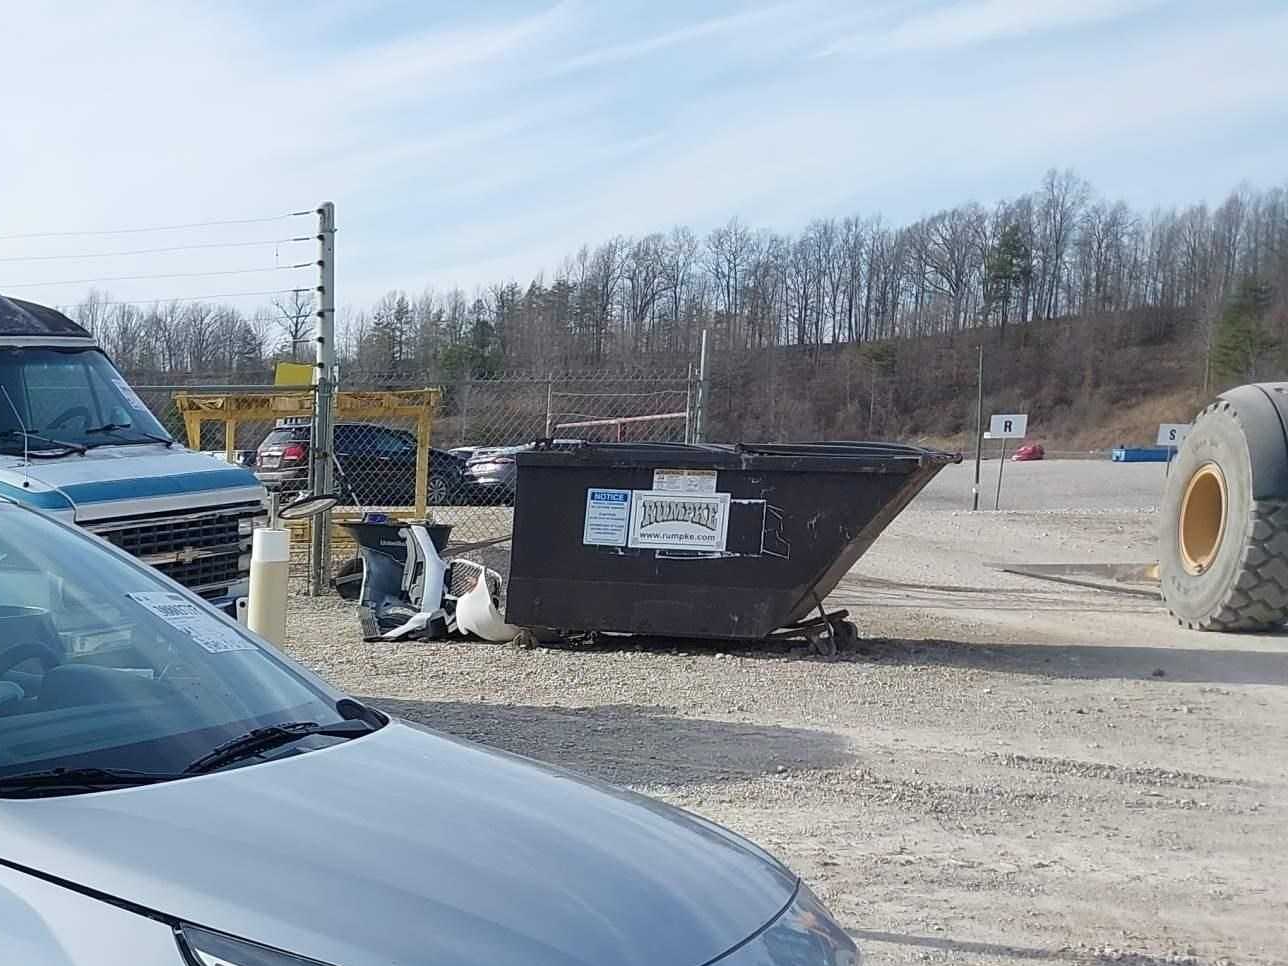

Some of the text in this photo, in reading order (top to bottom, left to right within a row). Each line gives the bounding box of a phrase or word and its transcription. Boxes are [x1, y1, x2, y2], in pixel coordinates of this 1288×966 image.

[1003, 420, 1013, 433] R
[1169, 429, 1177, 441] S
[594, 492, 625, 501] NOTICE
[640, 500, 720, 531] RUMPKE
[639, 532, 716, 542] www.rumpke.com
